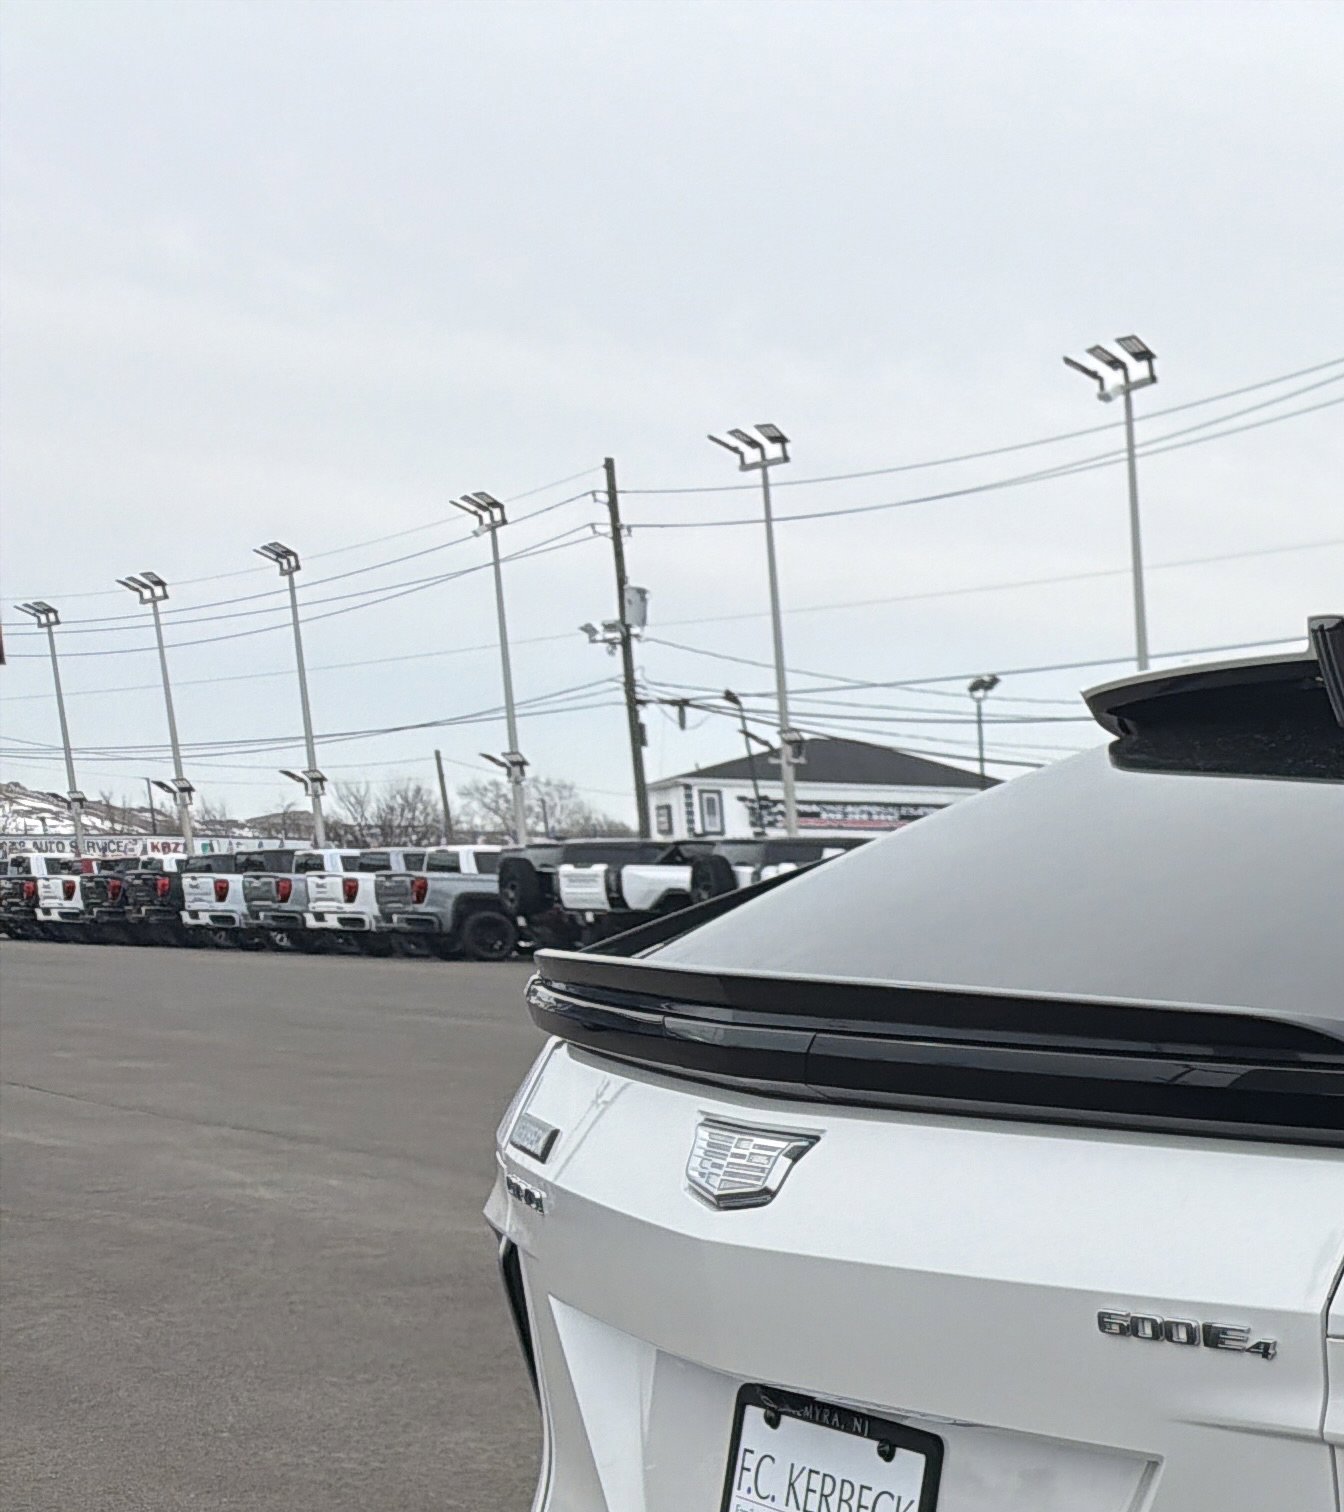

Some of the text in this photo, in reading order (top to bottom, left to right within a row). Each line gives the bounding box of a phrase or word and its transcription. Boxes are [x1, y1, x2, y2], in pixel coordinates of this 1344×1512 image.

[33, 841, 65, 854] AUTO
[69, 840, 123, 854] SRVICE
[737, 1447, 776, 1503] F.C.
